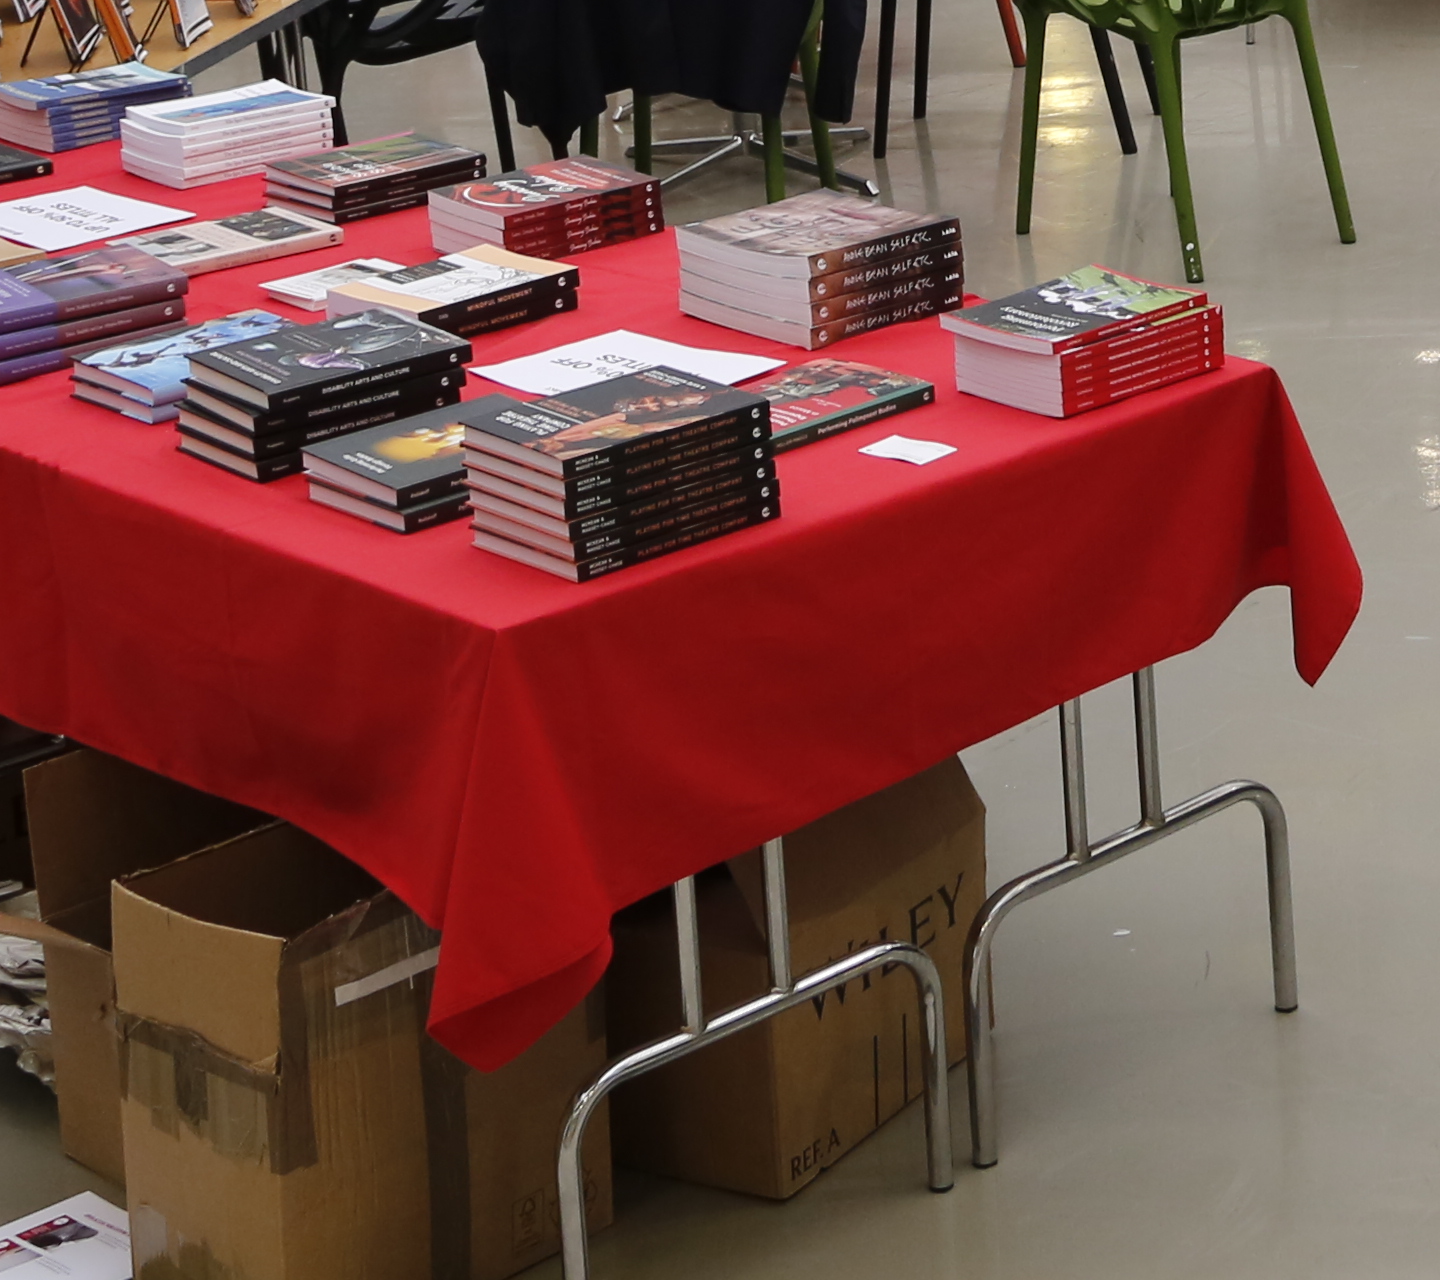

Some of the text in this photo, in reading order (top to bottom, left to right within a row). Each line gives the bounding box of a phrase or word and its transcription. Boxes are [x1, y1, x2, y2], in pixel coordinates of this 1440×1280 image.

[12, 203, 46, 216] OFF
[50, 202, 124, 224] ALL TITLES
[467, 287, 532, 312] MINDFUL MOVEMENT
[491, 309, 528, 324] MOVEMENT
[550, 356, 595, 370] OFF
[595, 353, 654, 370] ITLES
[322, 366, 410, 395] DISABILITY ARTS AND CULTURE
[308, 390, 400, 418] DISABILITY ARTS AND CULTURE
[306, 410, 396, 440] DISABILITY ARTS AND CULTURE
[817, 403, 897, 435] Performing Palimpsest Bodies
[811, 872, 965, 1021] WILEY
[791, 1127, 842, 1182] REF. A
